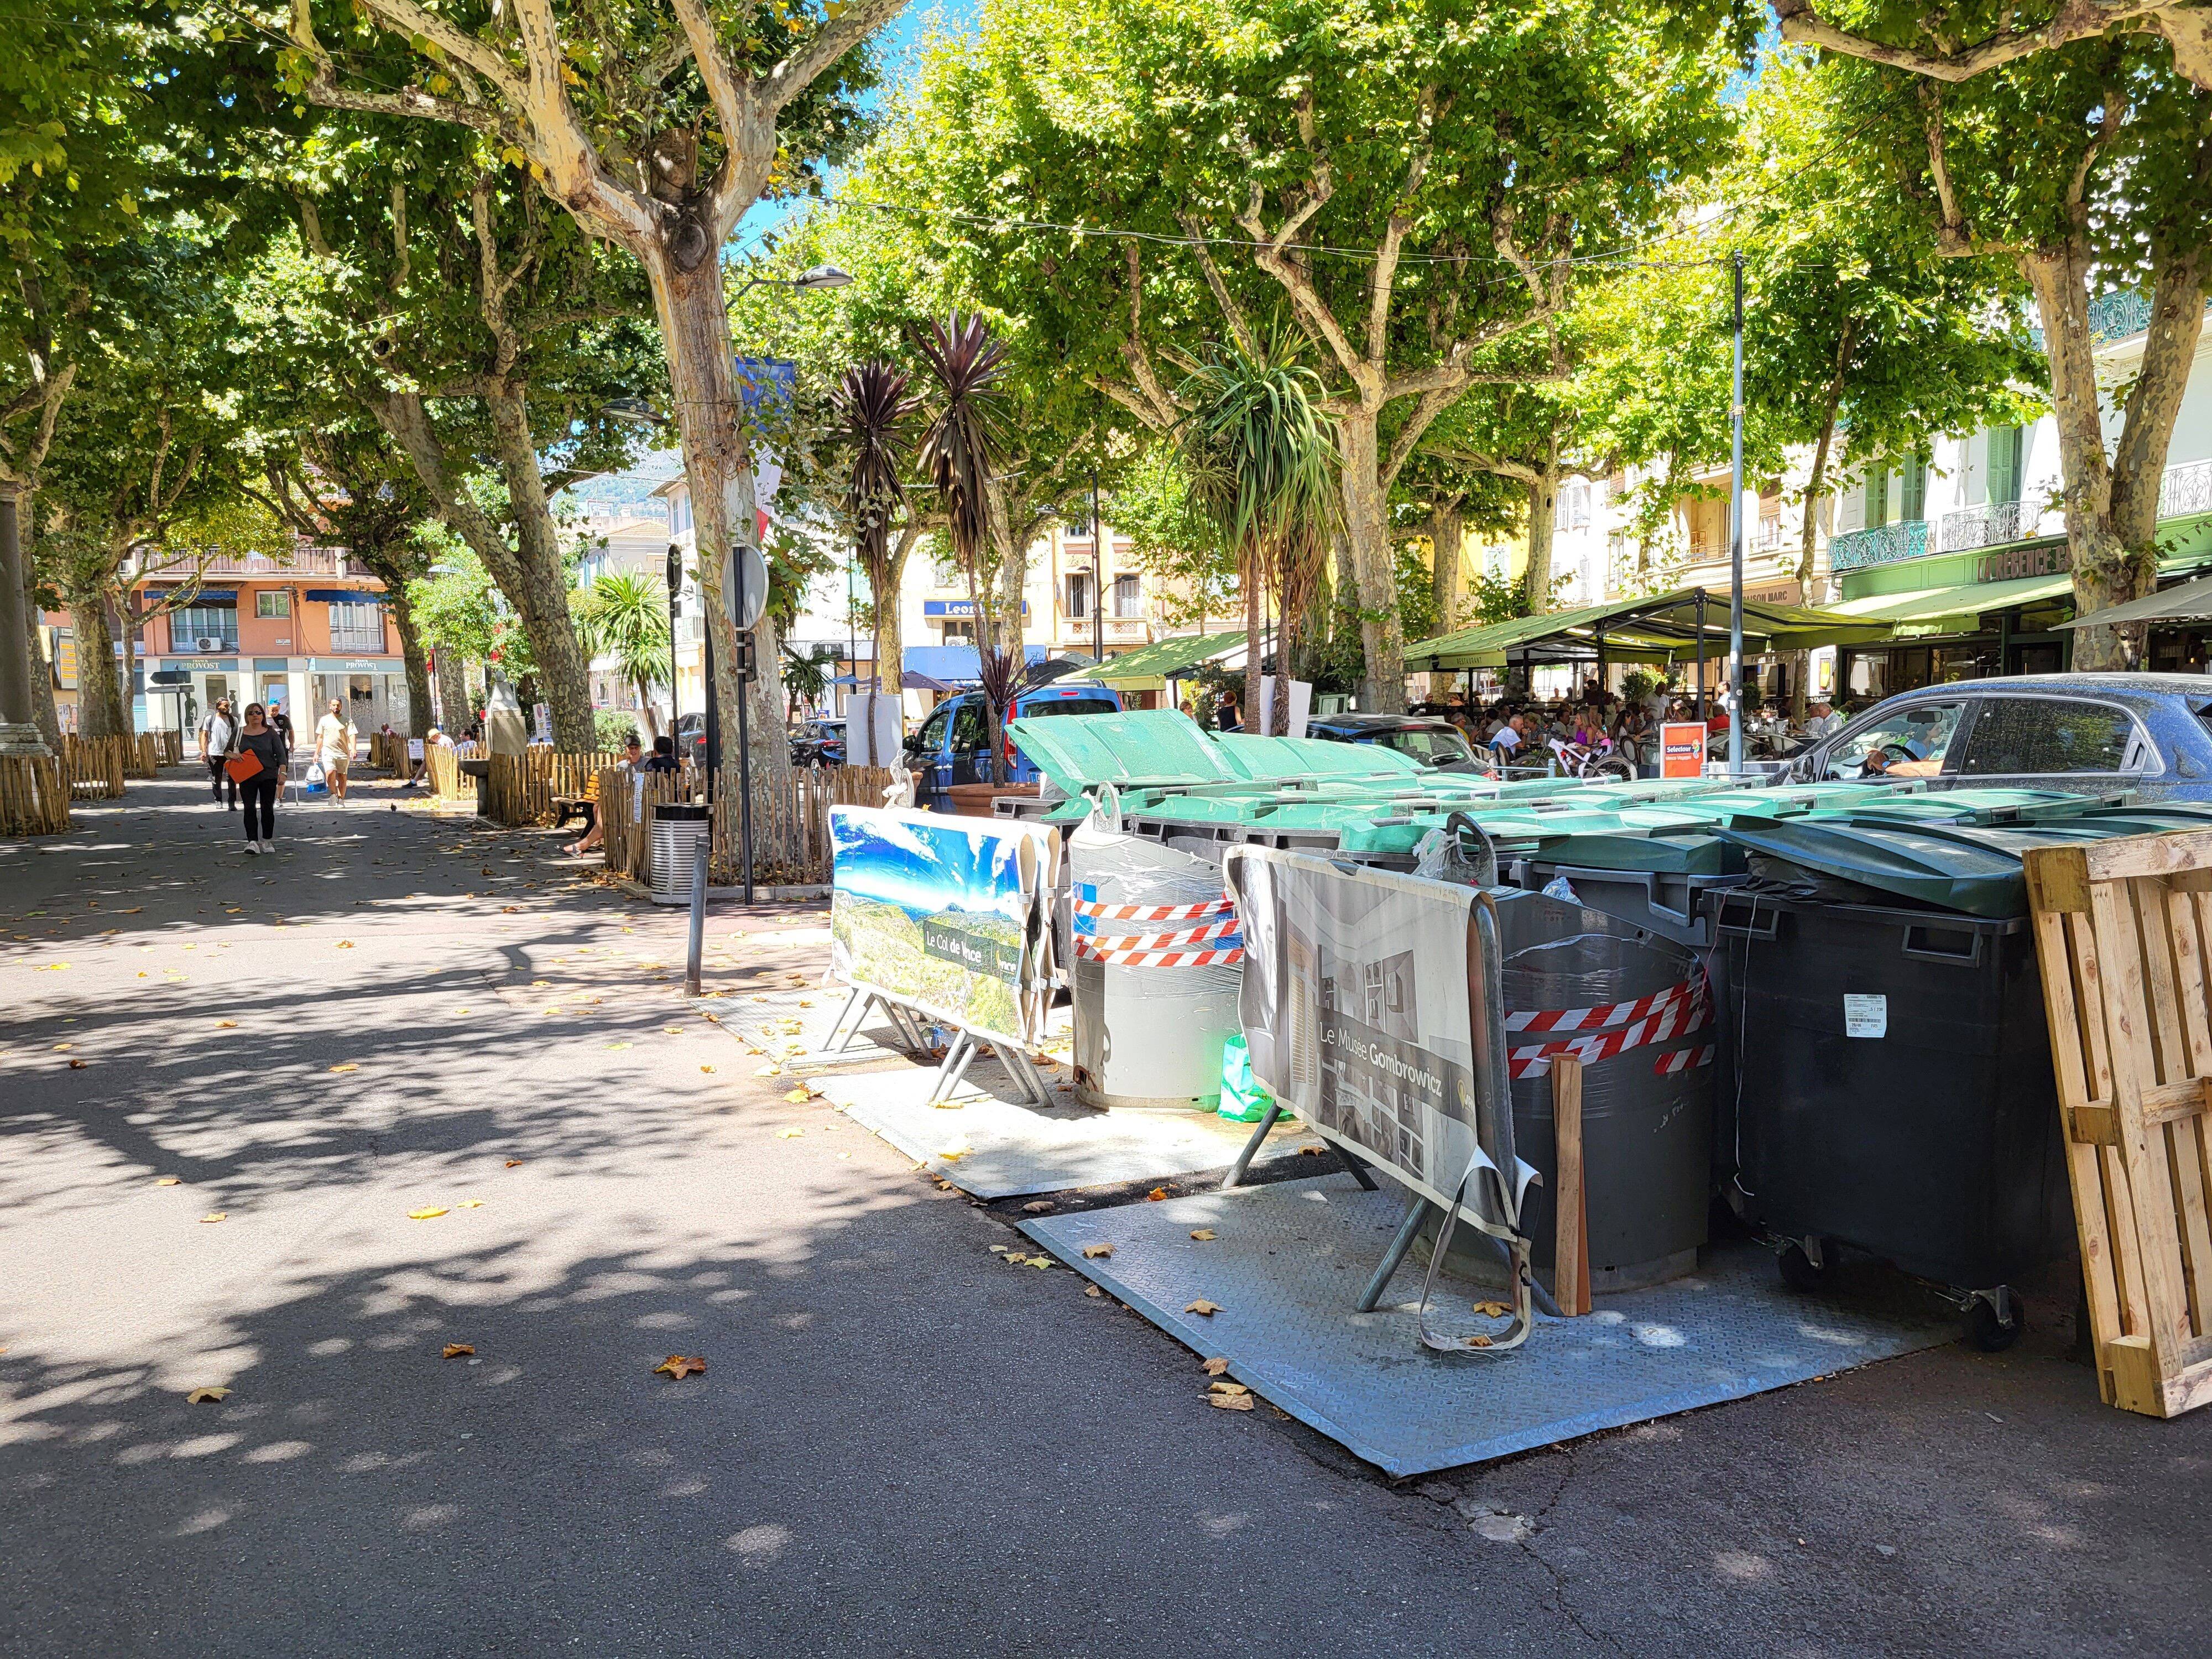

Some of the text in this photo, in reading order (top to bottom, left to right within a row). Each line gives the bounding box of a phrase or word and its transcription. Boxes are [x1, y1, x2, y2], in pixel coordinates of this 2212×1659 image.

[1978, 557, 1992, 582] LA
[1768, 590, 1787, 602] MARC
[1456, 656, 1481, 665] RESTAURANT
[926, 931, 982, 963] Le Col de Vnce
[1319, 1021, 1442, 1098] Le Musée Gombrowicz
